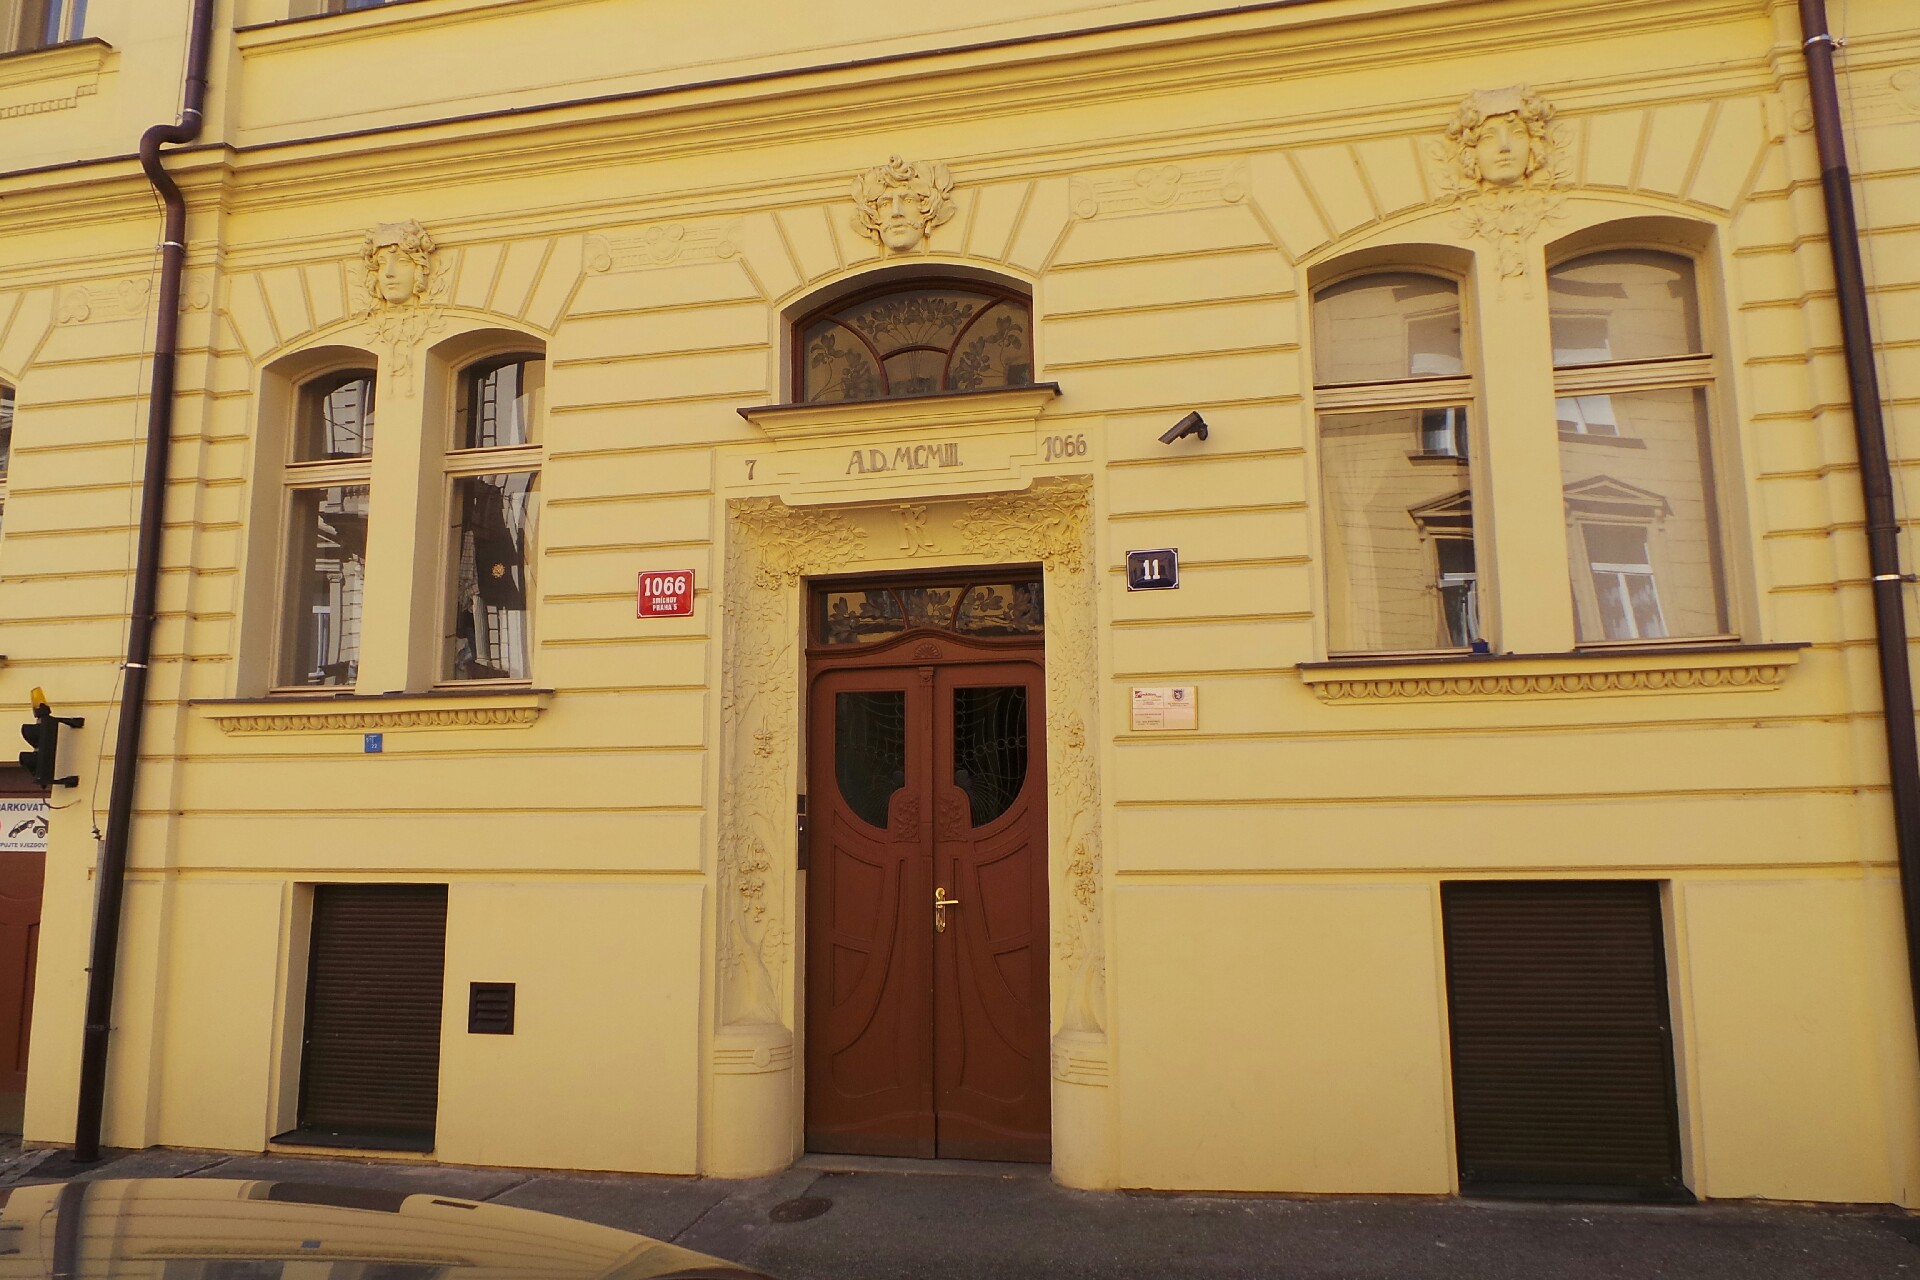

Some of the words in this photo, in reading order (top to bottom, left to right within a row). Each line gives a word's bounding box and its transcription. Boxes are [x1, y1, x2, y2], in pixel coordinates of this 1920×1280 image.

[1042, 434, 1087, 462] 1066
[745, 459, 757, 480] 7
[1143, 559, 1160, 580] 11
[644, 576, 686, 597] 1066
[0, 803, 45, 811] ARKOVAT
